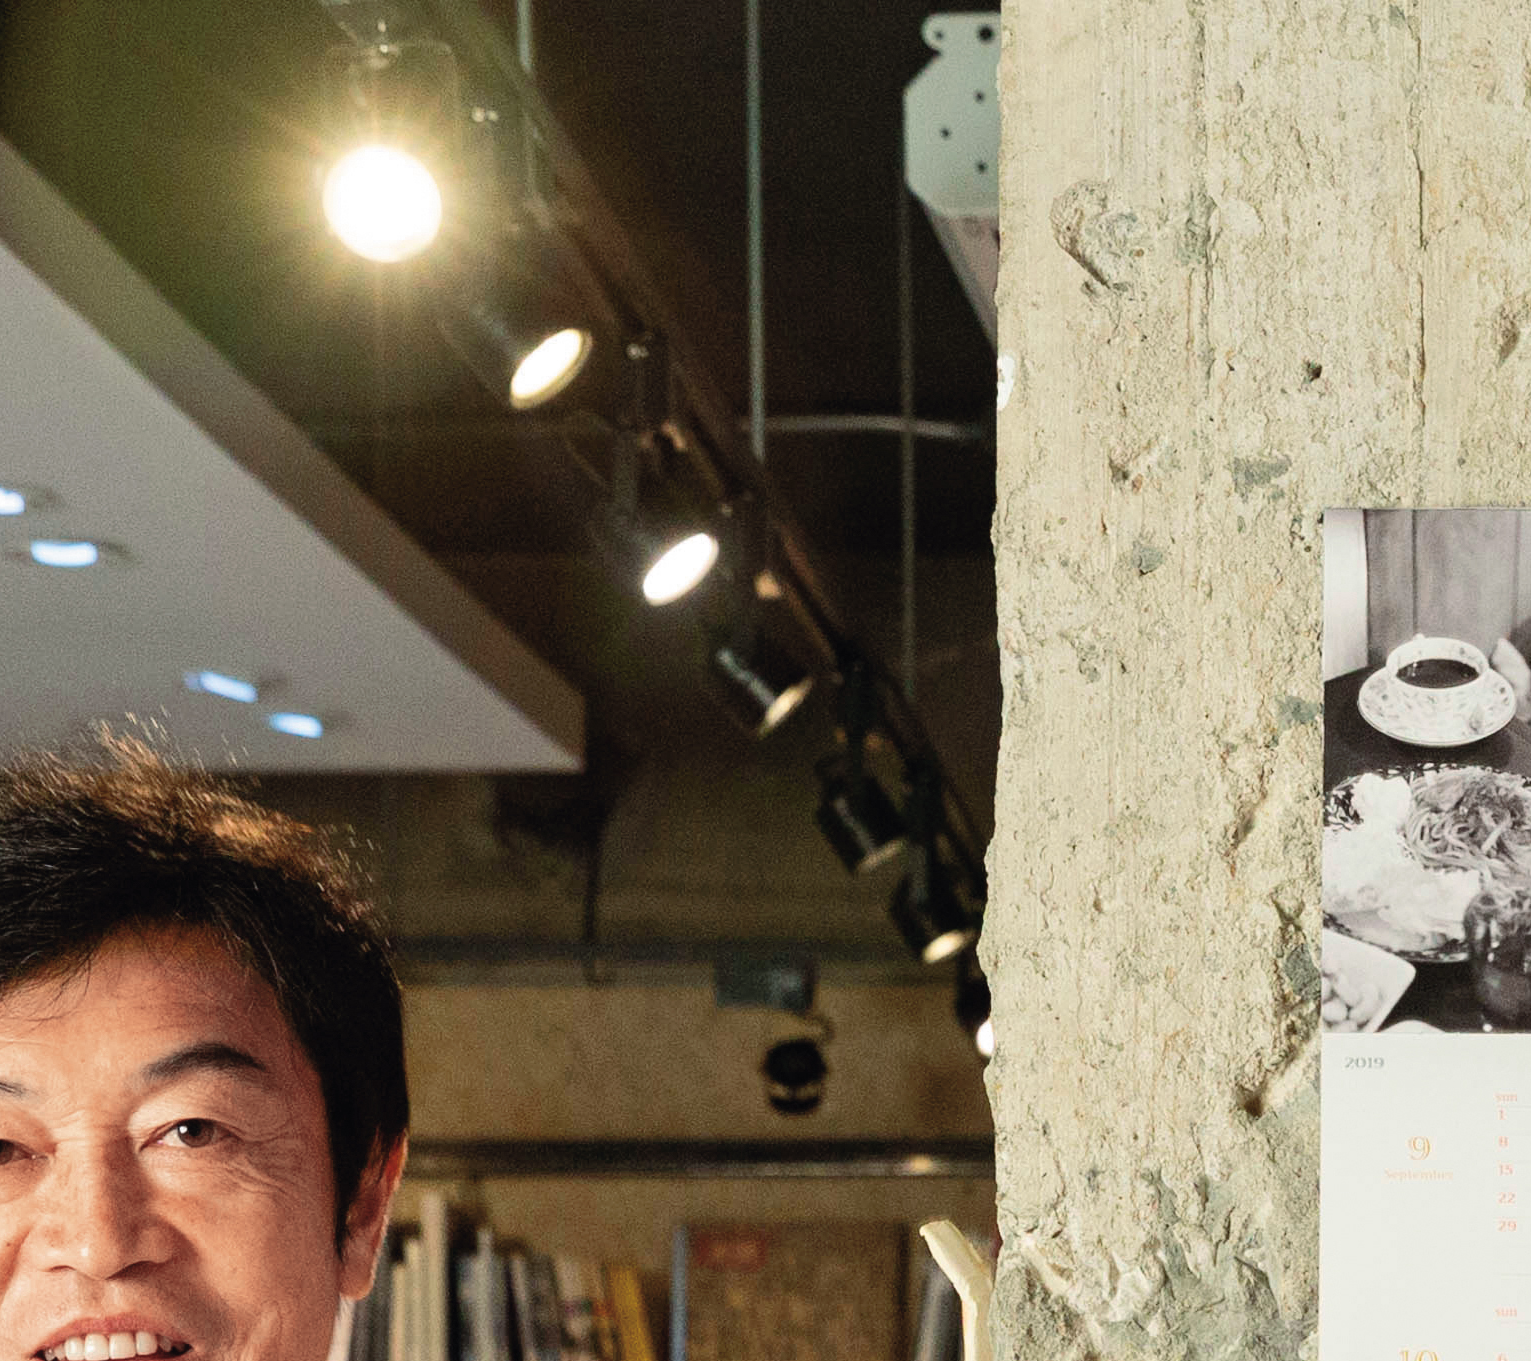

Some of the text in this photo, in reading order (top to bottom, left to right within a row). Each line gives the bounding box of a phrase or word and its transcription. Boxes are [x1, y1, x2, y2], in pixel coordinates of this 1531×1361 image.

[1344, 1056, 1385, 1069] 2019
[1407, 1136, 1431, 1161] 9
[1497, 1193, 1516, 1205] 22
[1497, 1221, 1518, 1232] 29
